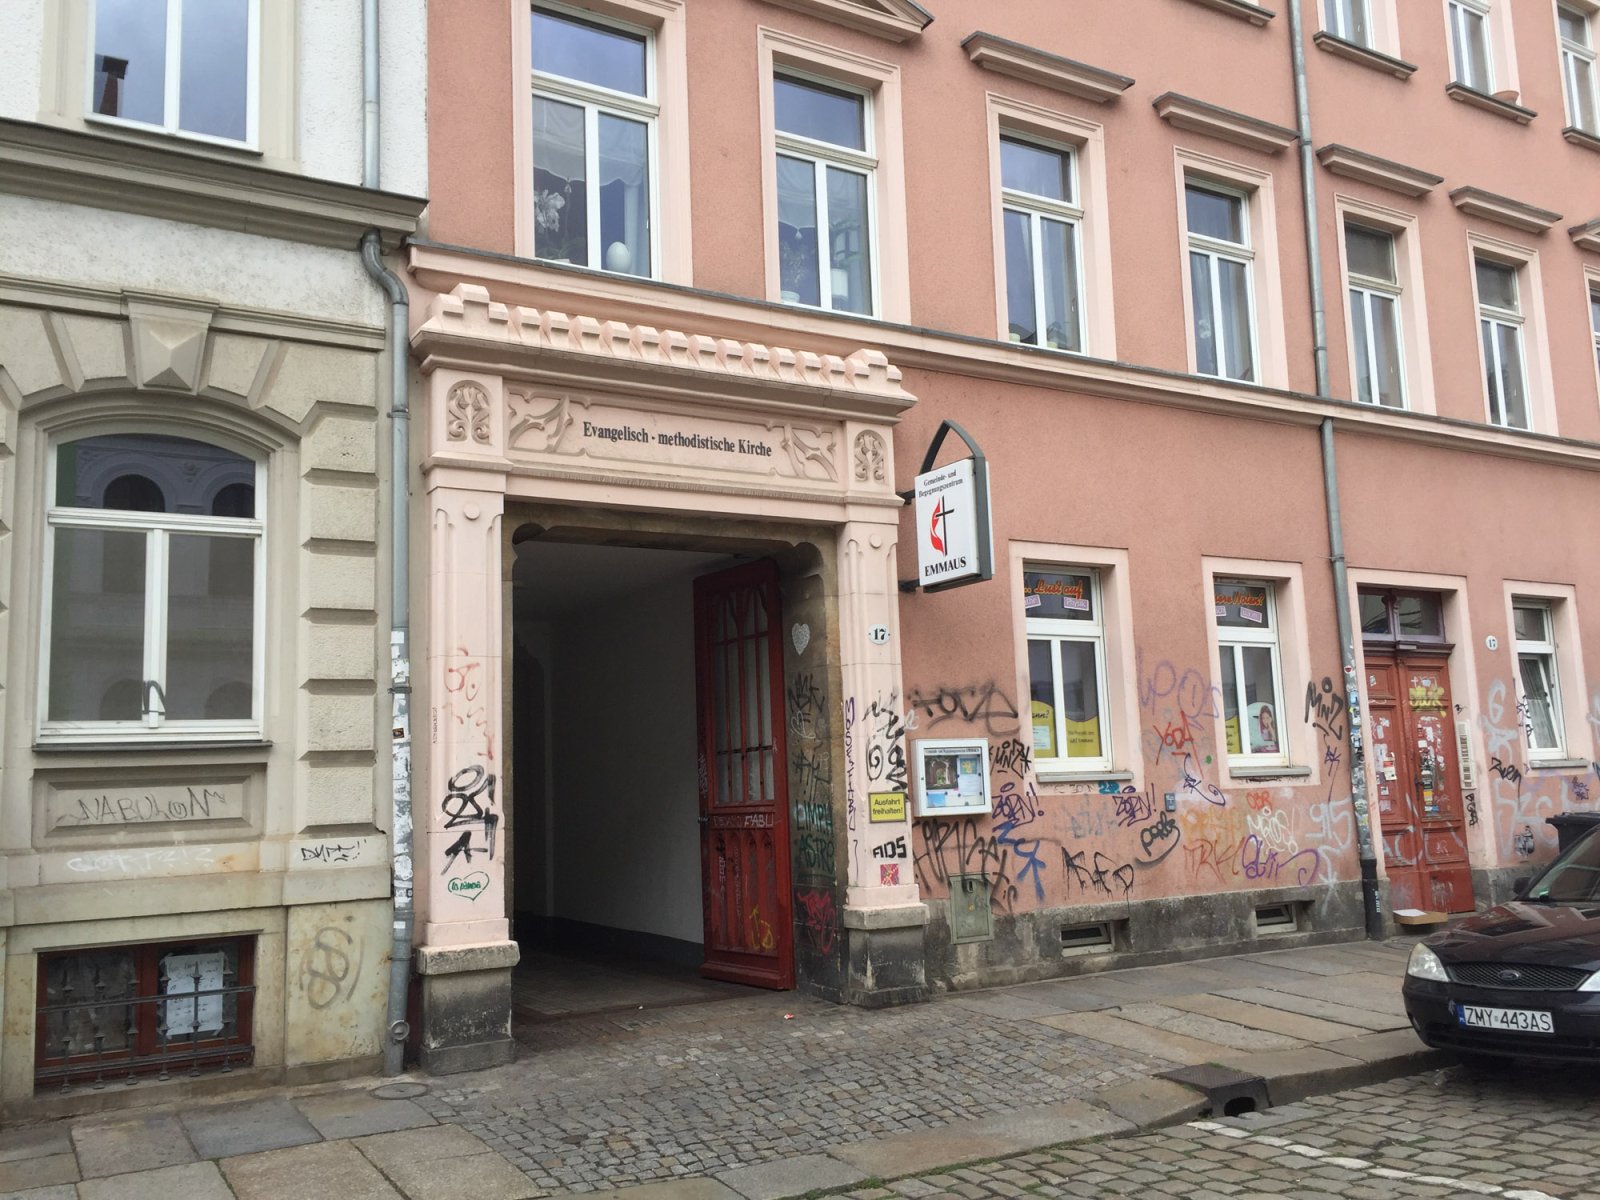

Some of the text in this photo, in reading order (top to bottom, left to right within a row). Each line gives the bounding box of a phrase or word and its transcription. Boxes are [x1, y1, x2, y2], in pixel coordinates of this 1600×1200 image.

[583, 421, 649, 443] Evangelisch
[658, 432, 735, 453] methodistische
[738, 439, 772, 457] Kirche
[948, 469, 957, 480] und
[924, 556, 967, 577] EMMAUS
[874, 628, 886, 640] 17
[872, 807, 903, 815] freihalten!
[1465, 1007, 1493, 1027] ZMY
[1500, 1010, 1551, 1032] 443AS
